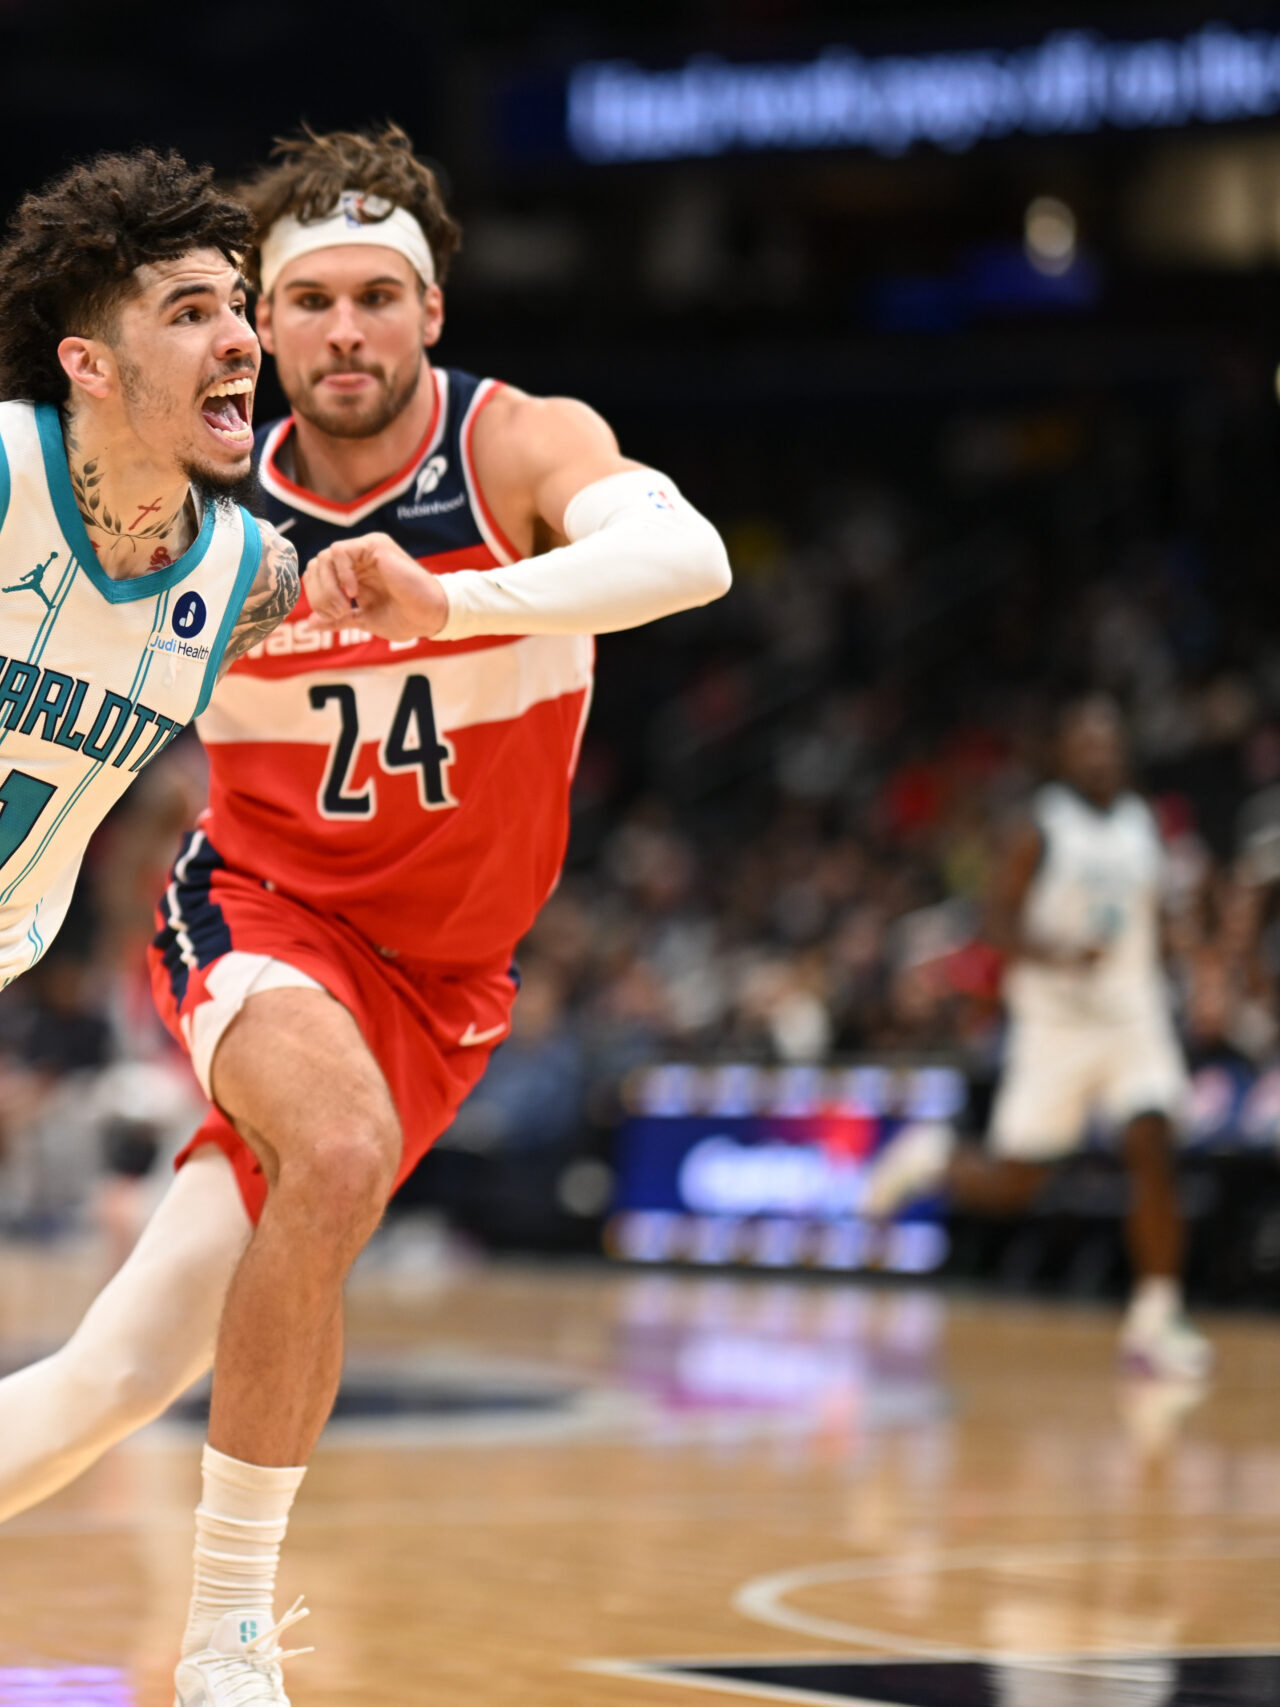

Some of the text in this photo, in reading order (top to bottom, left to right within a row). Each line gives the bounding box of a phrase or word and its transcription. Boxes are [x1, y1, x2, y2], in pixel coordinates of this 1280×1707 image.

[397, 493, 464, 519] Robinhood
[150, 635, 209, 660] Judi Health
[308, 673, 459, 820] 24
